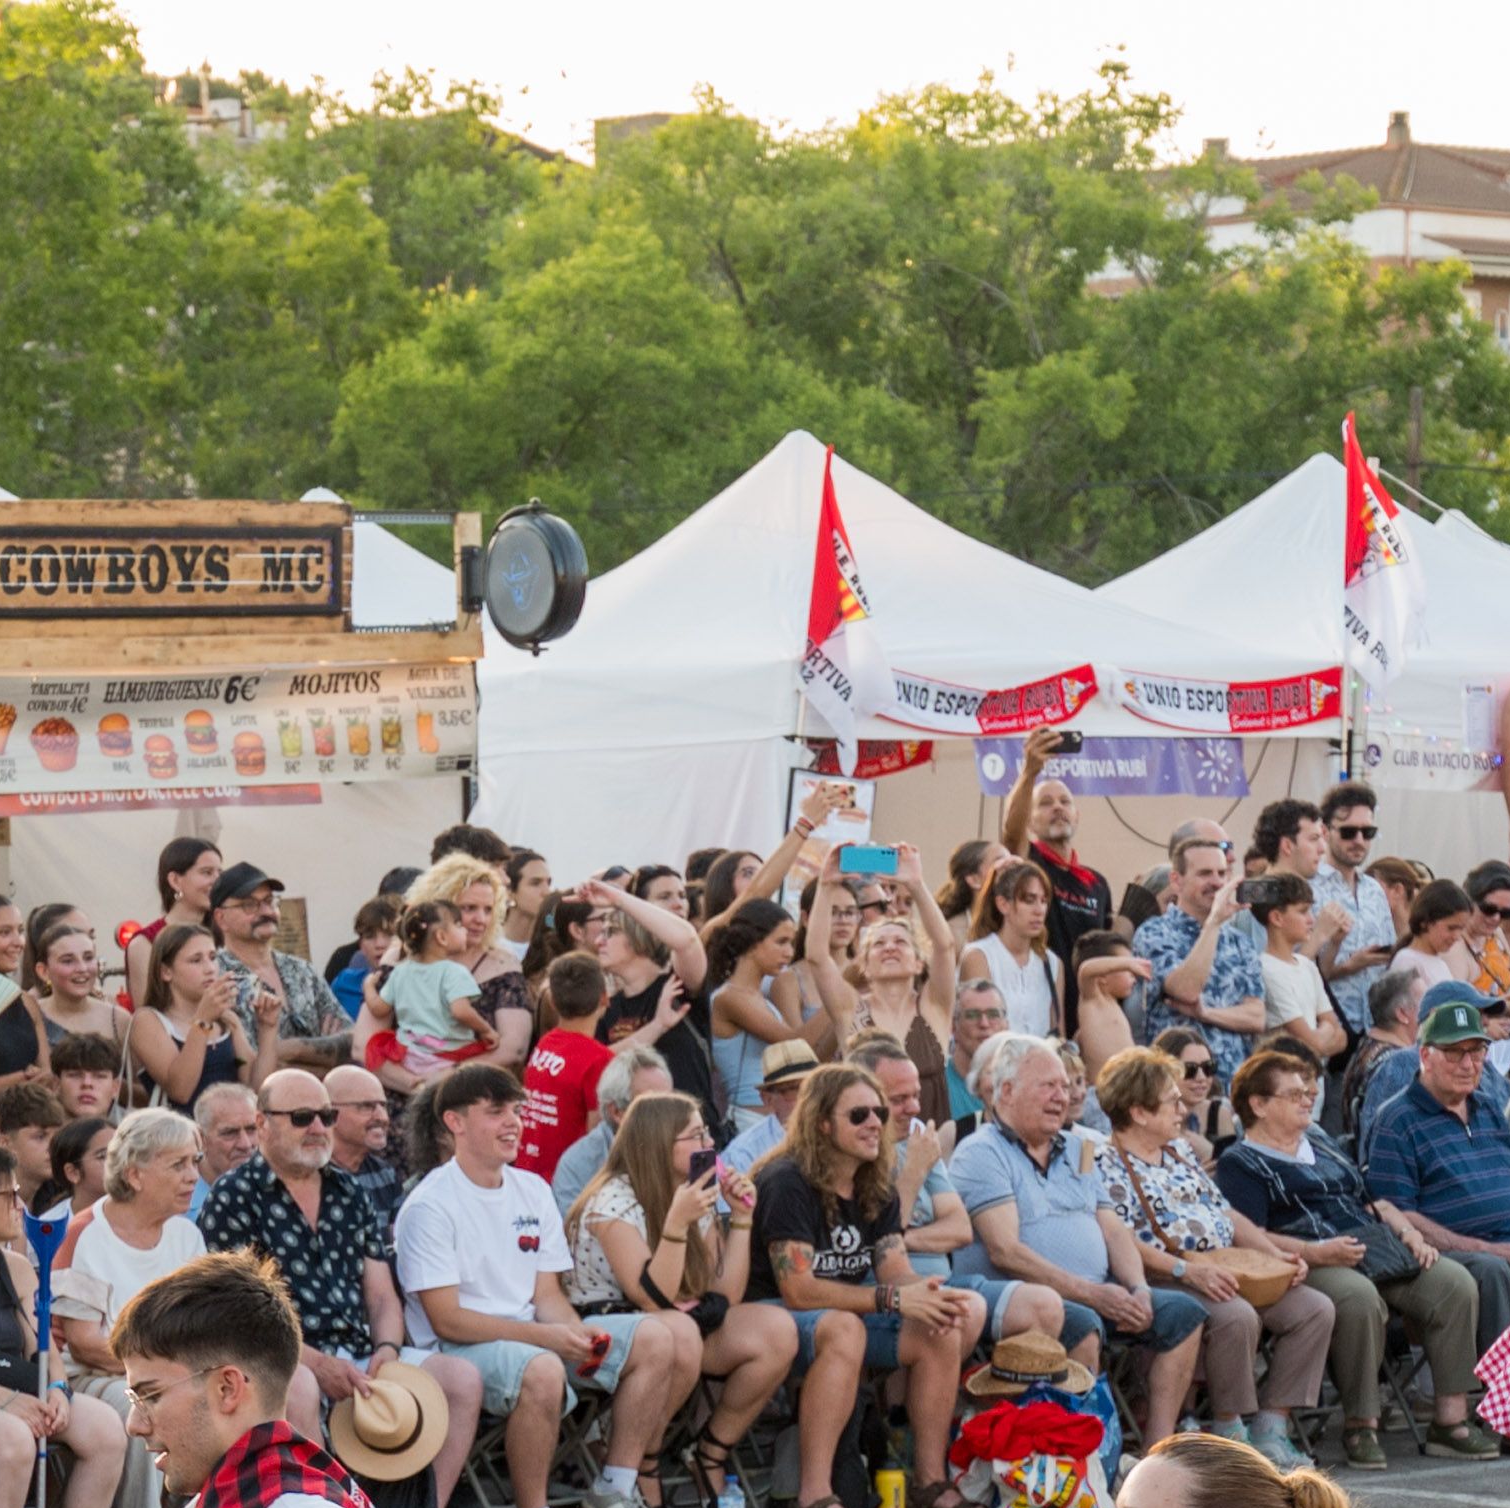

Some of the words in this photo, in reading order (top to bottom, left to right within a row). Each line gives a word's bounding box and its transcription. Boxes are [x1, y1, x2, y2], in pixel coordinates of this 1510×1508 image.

[258, 544, 325, 594] MC
[30, 682, 91, 696] TARTALETA
[103, 677, 224, 704] HAMBURGUESAS
[224, 675, 261, 705] 6€
[288, 670, 382, 697] MOJITOS
[933, 688, 1022, 718] ESPORTIVA
[1185, 686, 1269, 714] ESPORTIVA
[1116, 753, 1148, 779] RUBÍ
[1393, 749, 1420, 768] CLUB
